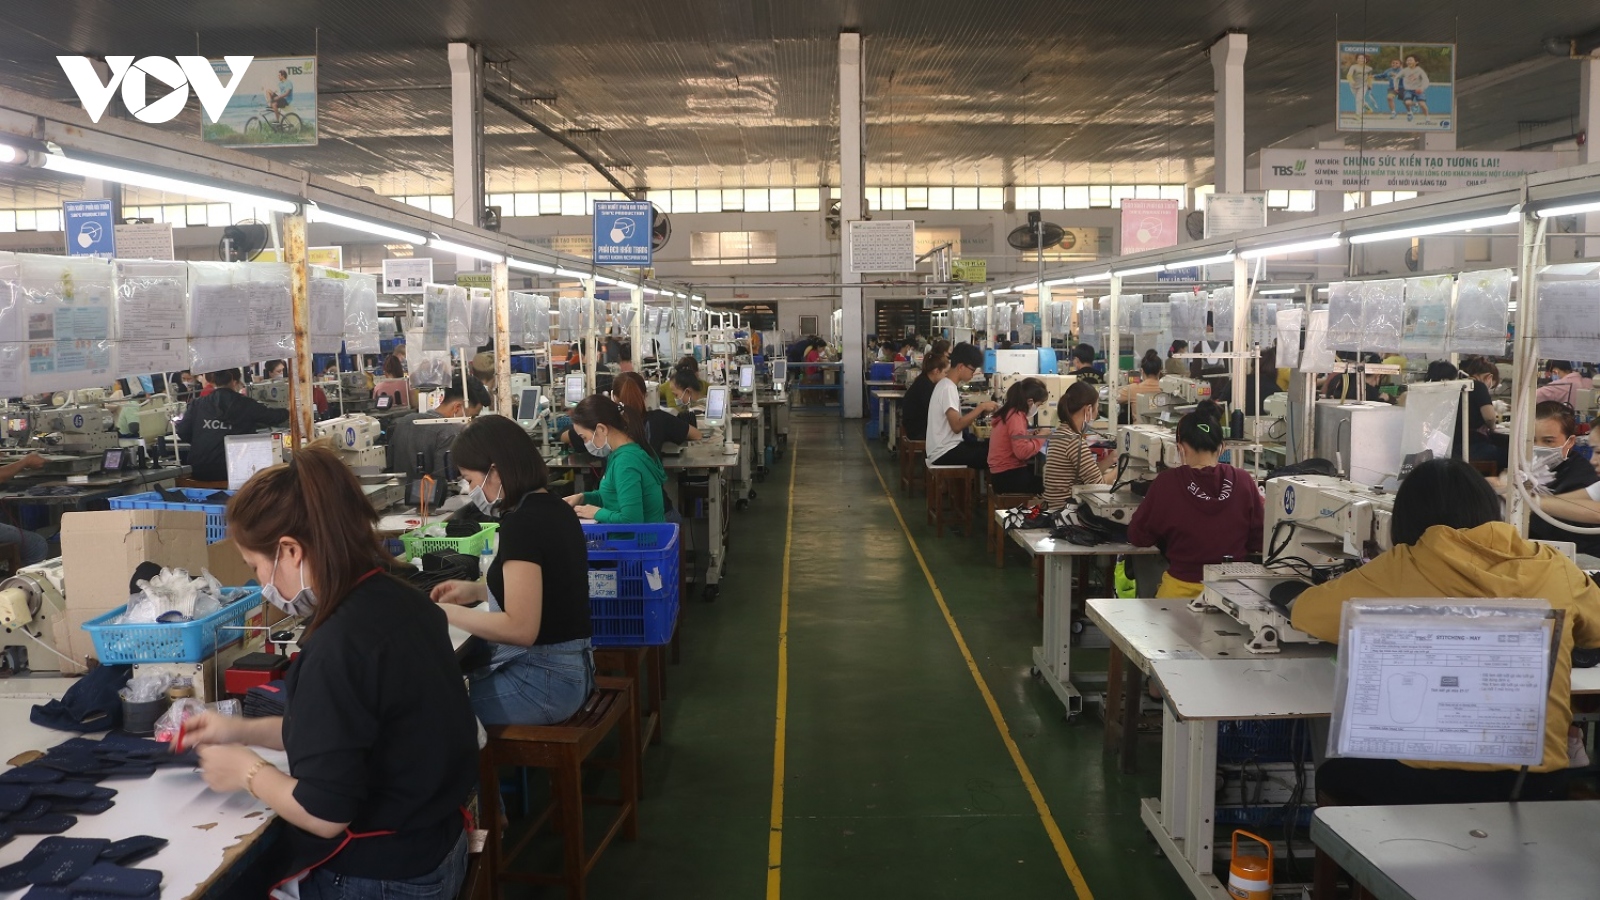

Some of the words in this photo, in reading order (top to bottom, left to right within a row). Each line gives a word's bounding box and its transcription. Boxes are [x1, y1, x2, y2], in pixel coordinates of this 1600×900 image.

[286, 66, 303, 75] TBS
[1343, 157, 1375, 167] CHUNG
[1378, 155, 1397, 167] SỨC
[1399, 153, 1421, 167] KIẾN
[1425, 157, 1443, 169] TẠO
[1446, 157, 1478, 168] TƯƠNG
[1481, 158, 1500, 168] LAI!
[1272, 165, 1293, 176] TBS
[1285, 489, 1294, 510] 26
